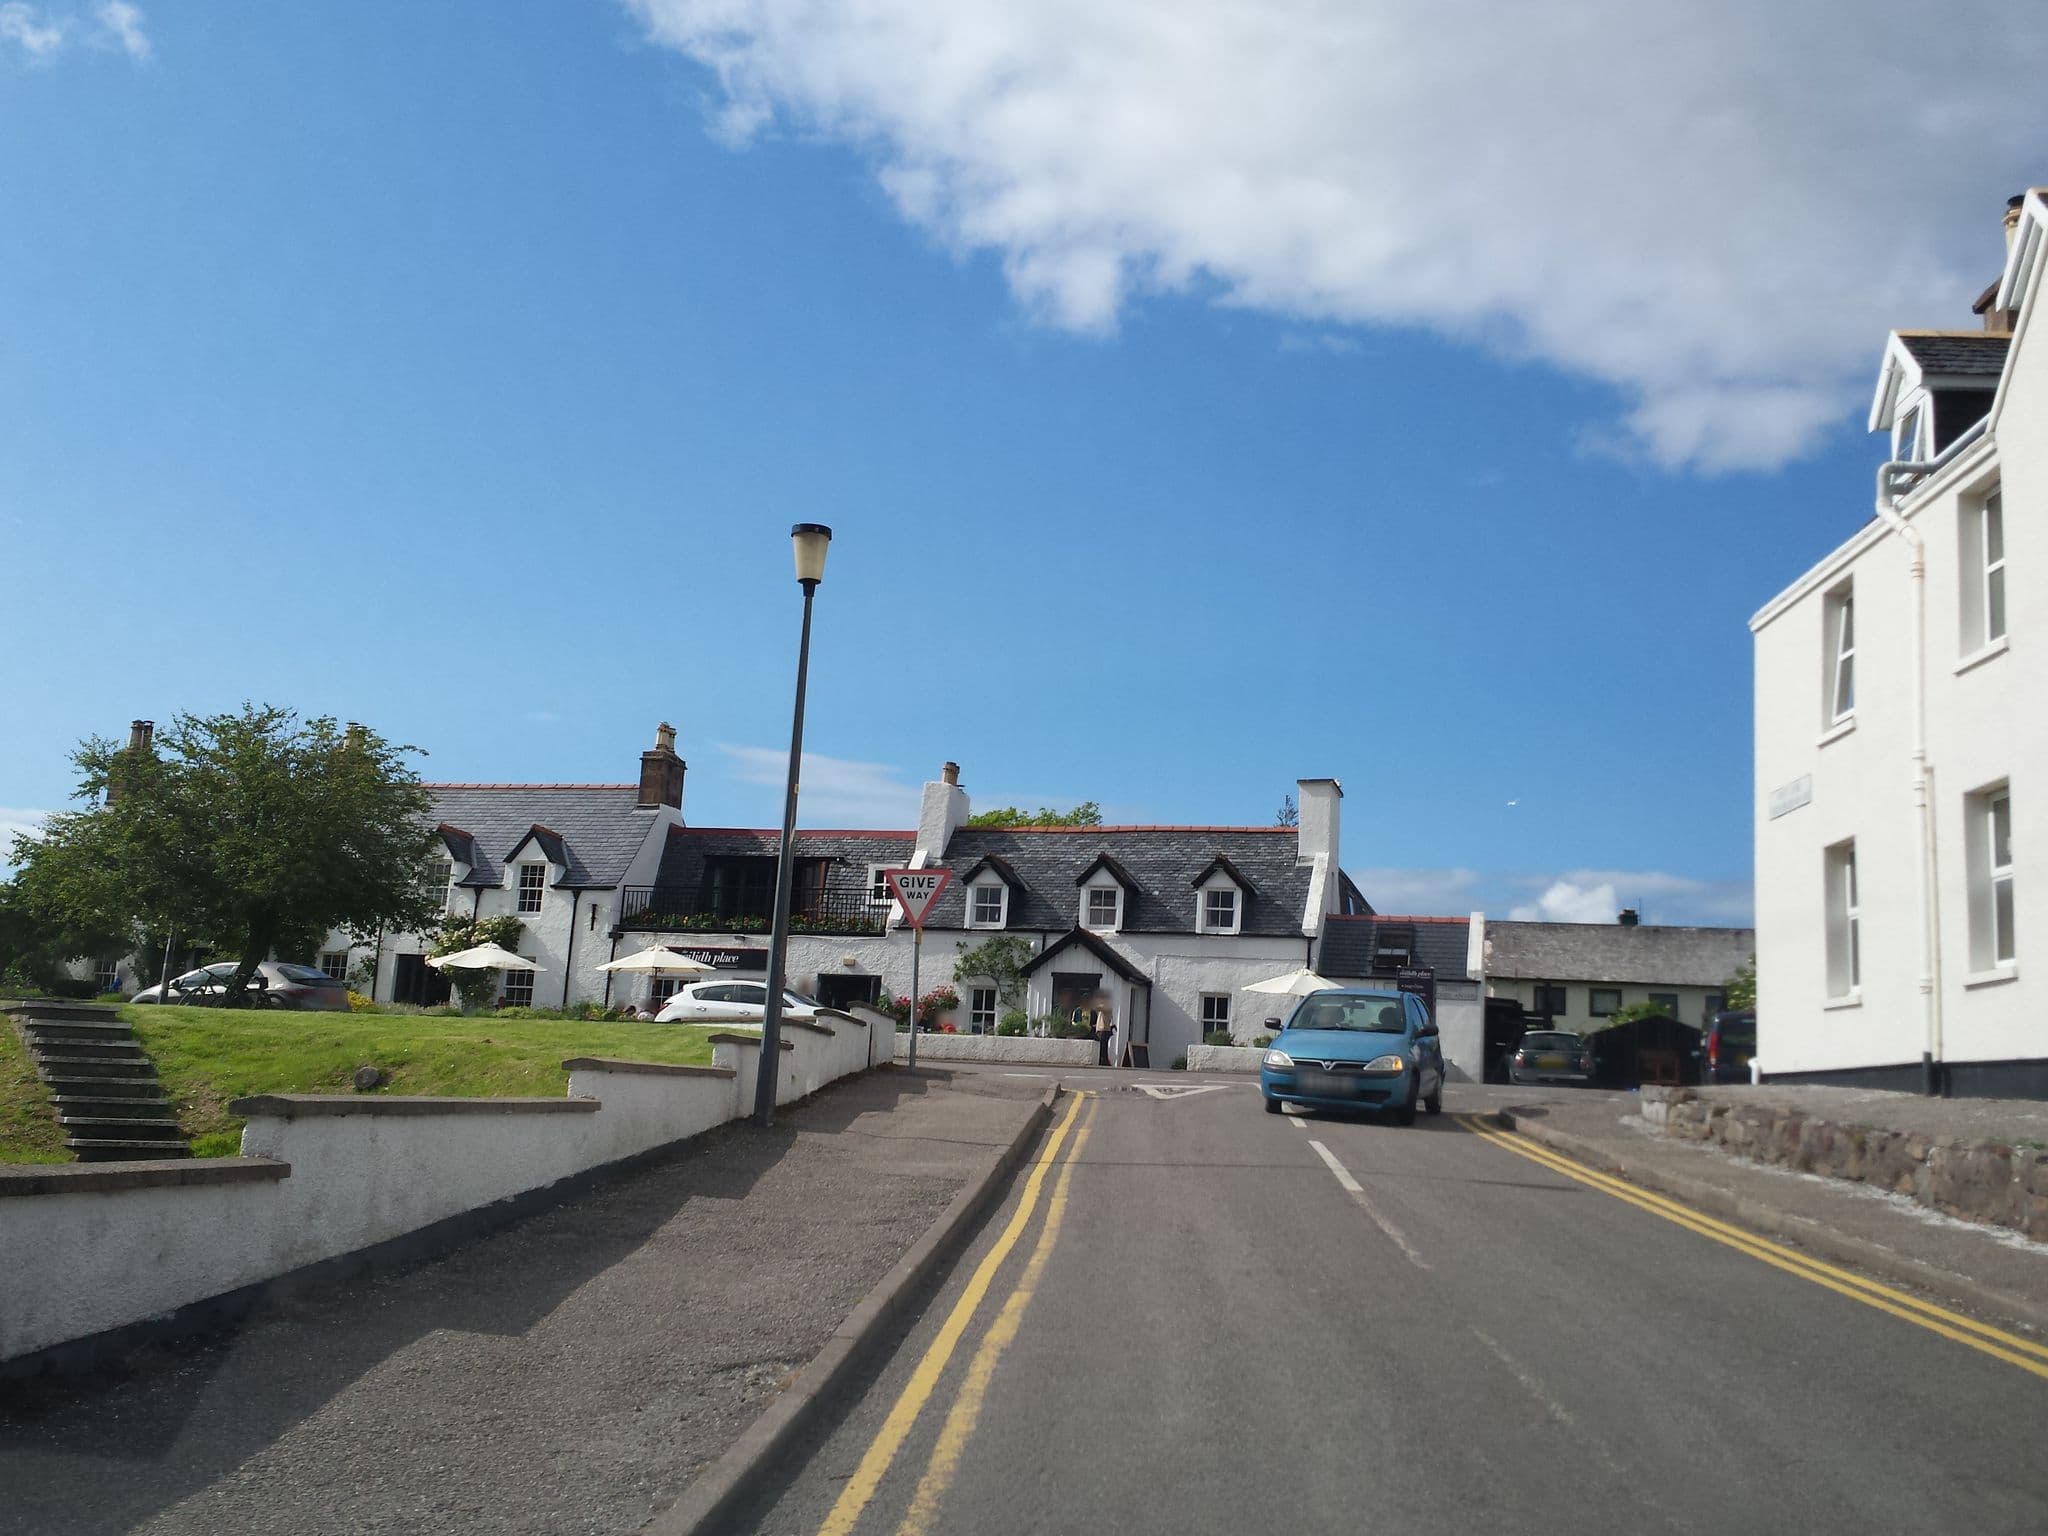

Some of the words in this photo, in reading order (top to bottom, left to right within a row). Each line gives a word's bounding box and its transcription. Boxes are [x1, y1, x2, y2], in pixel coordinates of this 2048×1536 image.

[900, 877, 935, 888] GIVE
[906, 891, 929, 899] WAY
[711, 952, 739, 965] place
